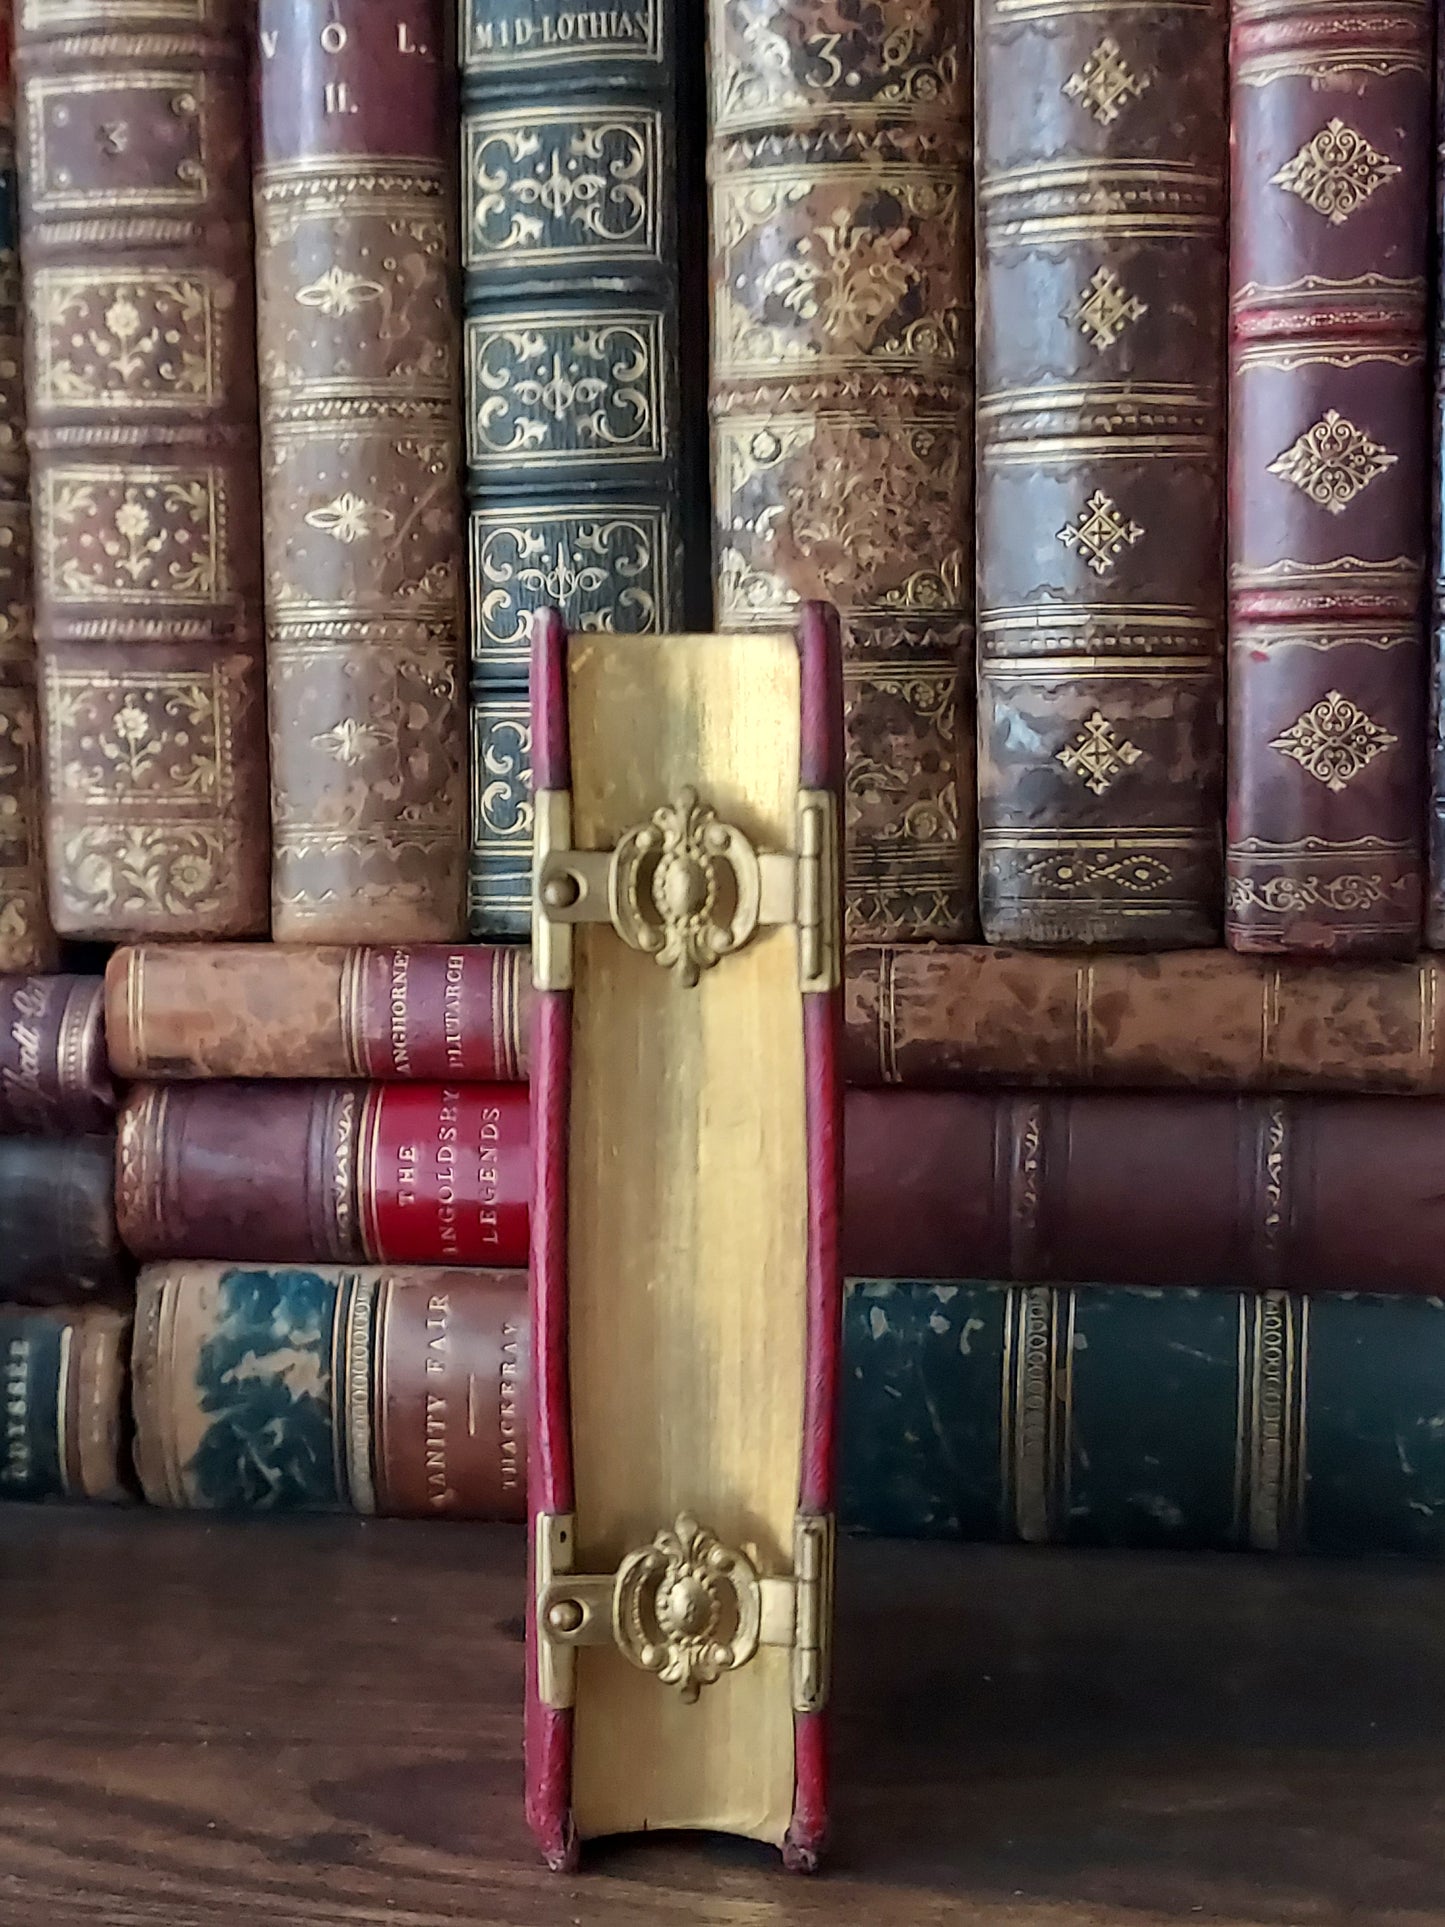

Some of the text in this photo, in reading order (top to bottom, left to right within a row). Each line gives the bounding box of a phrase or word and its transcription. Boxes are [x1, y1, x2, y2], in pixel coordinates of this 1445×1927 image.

[475, 11, 649, 48] MID-LOTHIAN
[325, 81, 358, 114] II.
[445, 954, 465, 1068] PLUTARCH
[397, 1144, 416, 1207] THE
[436, 1089, 460, 1255] INGOLDSBY
[478, 1107, 501, 1244] LEGENDS
[425, 1293, 451, 1375] FAIR
[500, 1321, 519, 1491] THACKERAY
